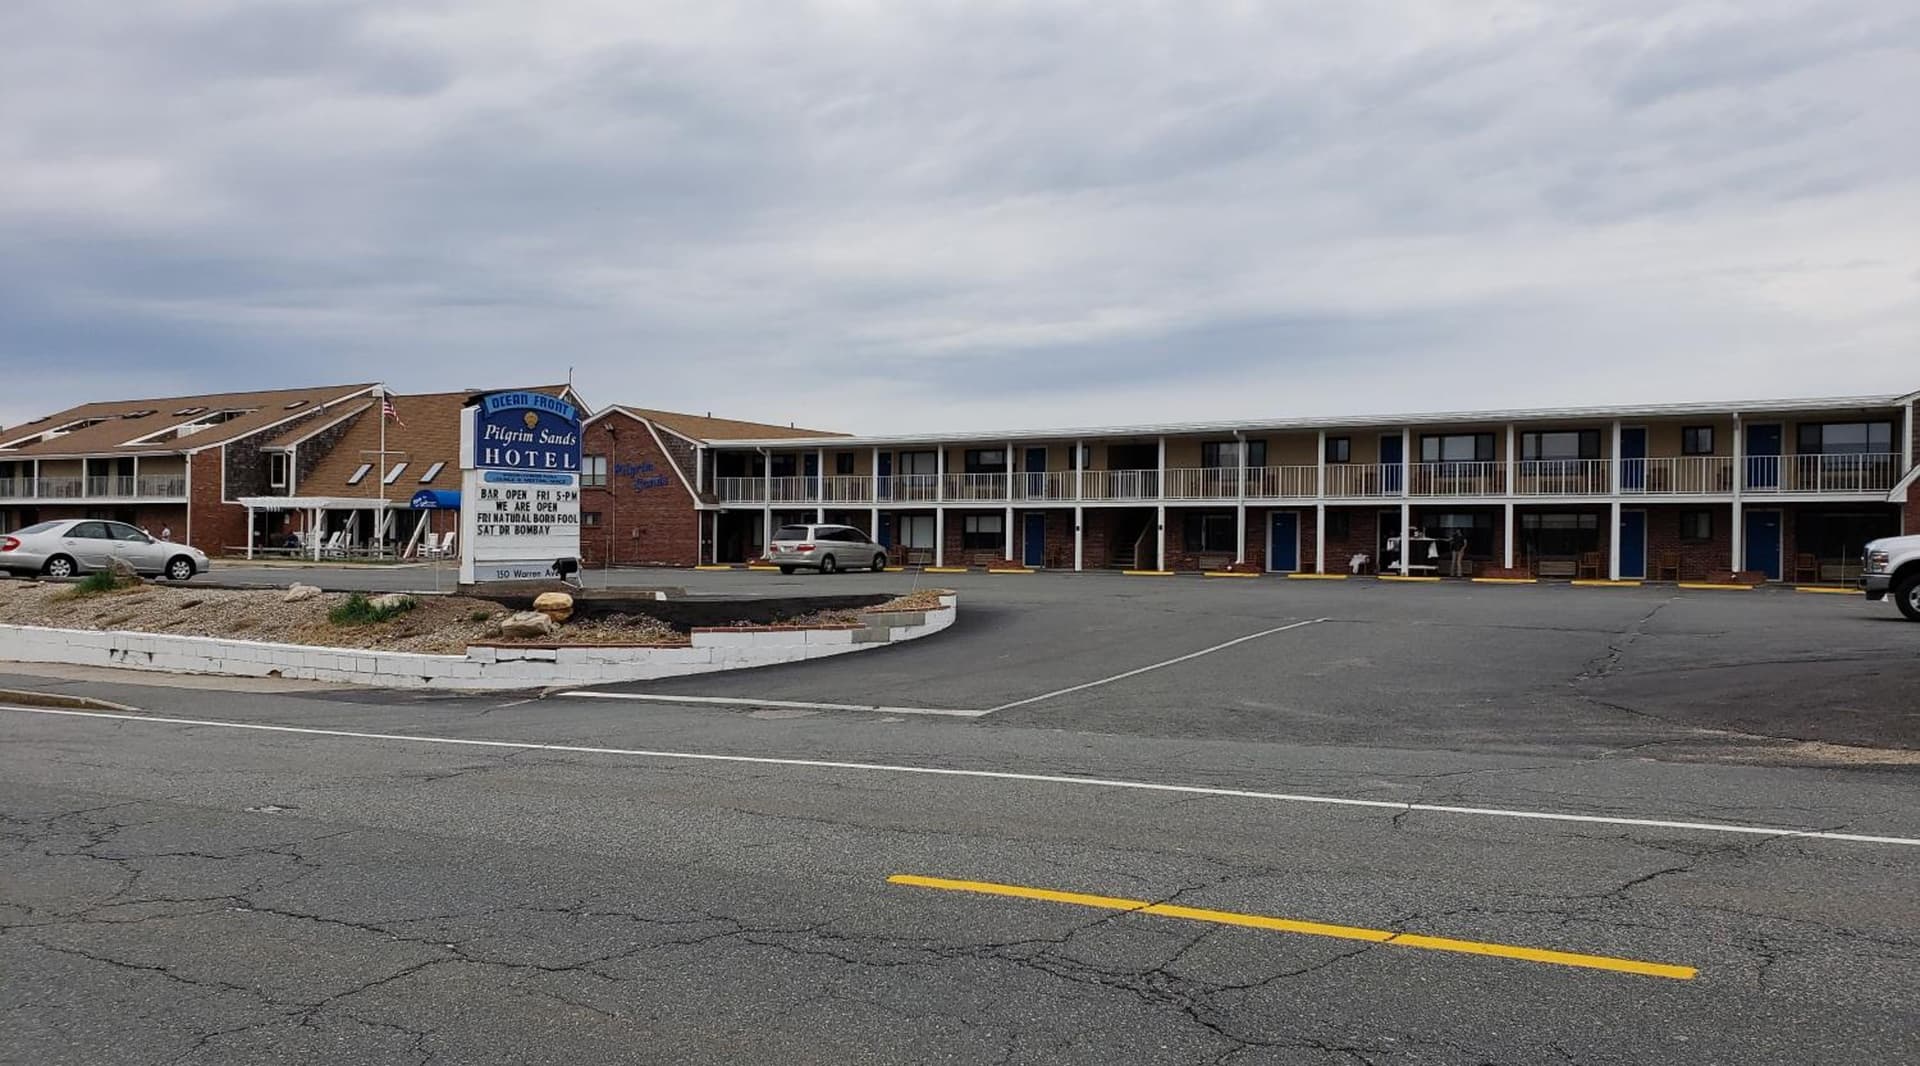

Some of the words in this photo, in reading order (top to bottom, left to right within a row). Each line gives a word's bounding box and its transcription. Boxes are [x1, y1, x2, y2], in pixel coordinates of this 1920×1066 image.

[492, 394, 528, 409] OCEAN
[534, 395, 569, 415] FRONT
[484, 424, 534, 446] Pilgrim
[539, 428, 577, 446] Sands
[485, 447, 576, 469] HOTEL
[481, 488, 499, 499] BAR
[505, 489, 527, 500] OPEN
[536, 490, 550, 501] FRI
[496, 501, 508, 512] WE
[514, 501, 530, 512] ARE
[536, 502, 557, 513] OPEN
[477, 512, 491, 523] FRI
[493, 513, 532, 524] NATURAL
[533, 513, 555, 524] BORN
[557, 514, 578, 524] FOOL
[477, 525, 494, 536] SAT
[499, 525, 511, 536] DR
[514, 525, 550, 536] BOMBAY
[496, 569, 510, 579] 150
[513, 569, 541, 578] Warren
